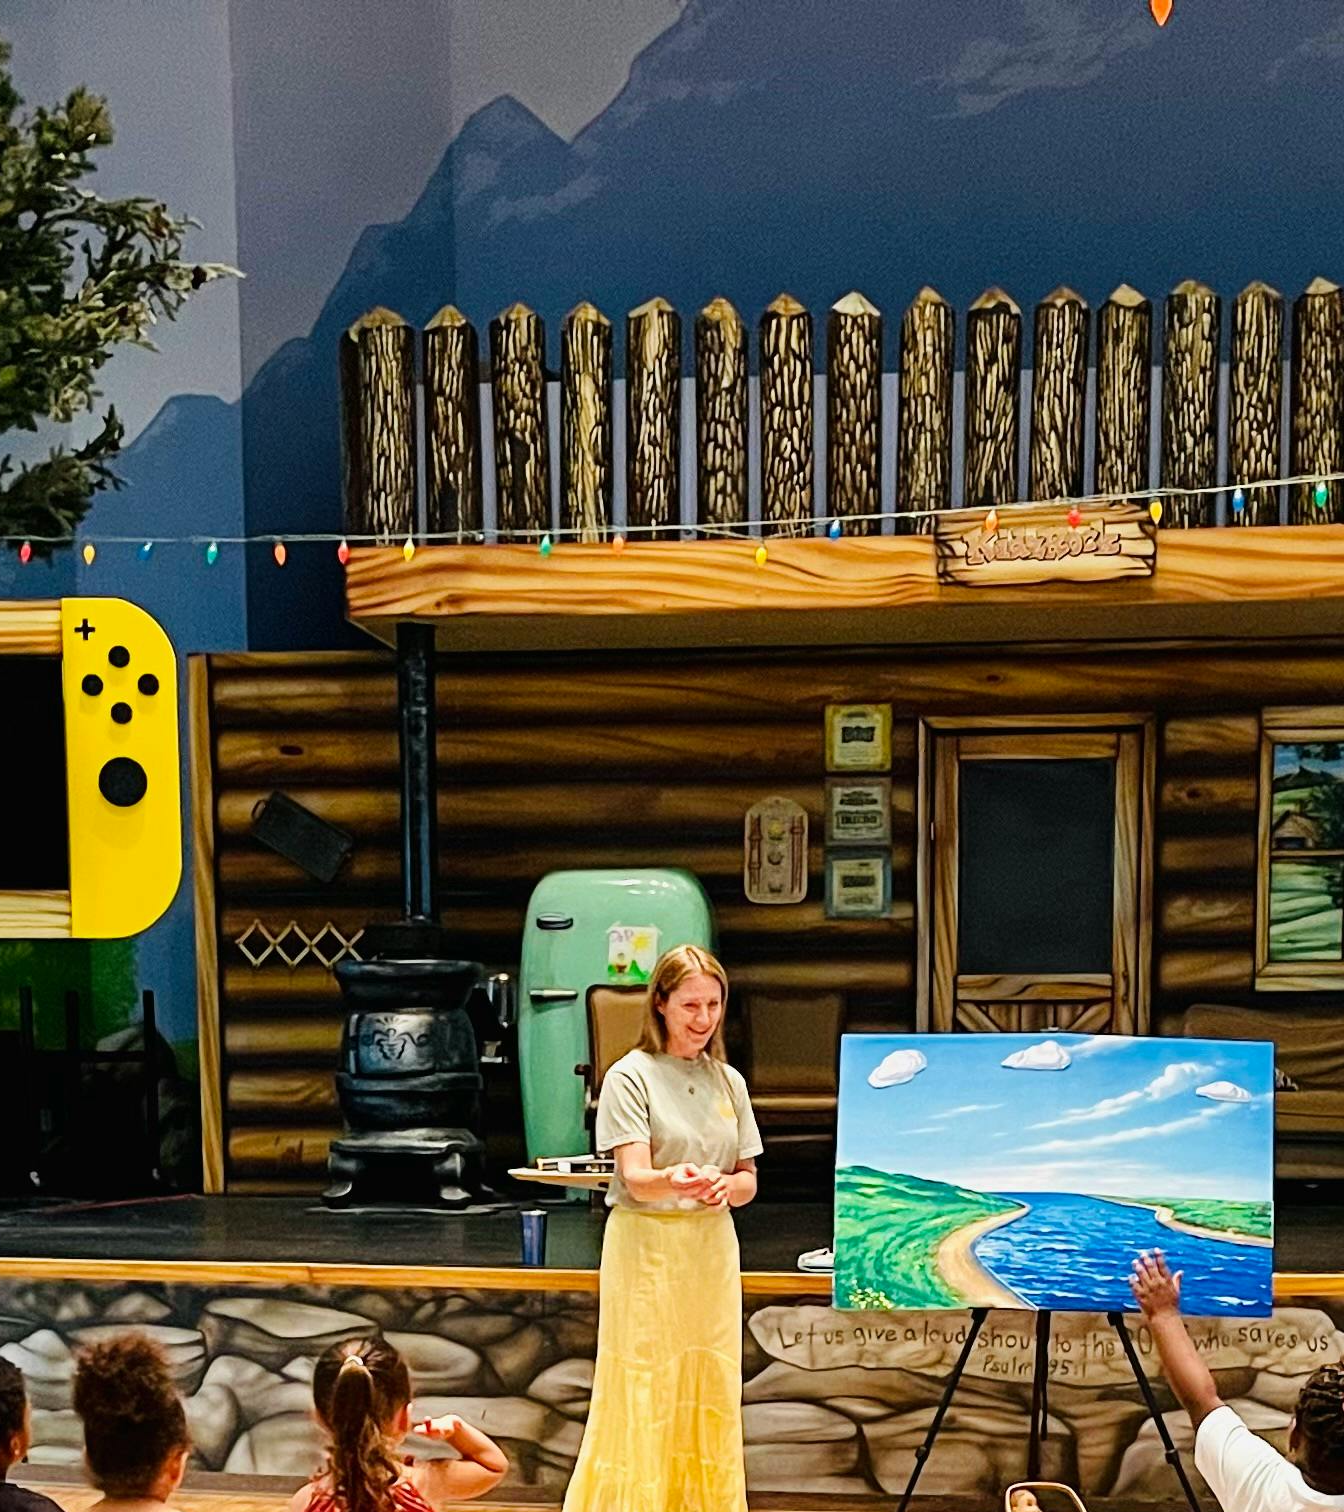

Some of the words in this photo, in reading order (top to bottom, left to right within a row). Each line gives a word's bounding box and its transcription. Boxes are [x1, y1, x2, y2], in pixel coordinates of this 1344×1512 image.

[776, 1322, 816, 1349] Let
[823, 1331, 845, 1345] us
[853, 1327, 897, 1346] give
[904, 1327, 917, 1342] a
[924, 1320, 967, 1346] loud
[977, 1327, 1031, 1350] shou
[1055, 1332, 1072, 1353] to
[1079, 1332, 1115, 1358] the
[1193, 1328, 1232, 1352] who
[1238, 1325, 1298, 1350] saves
[1307, 1333, 1329, 1353] us
